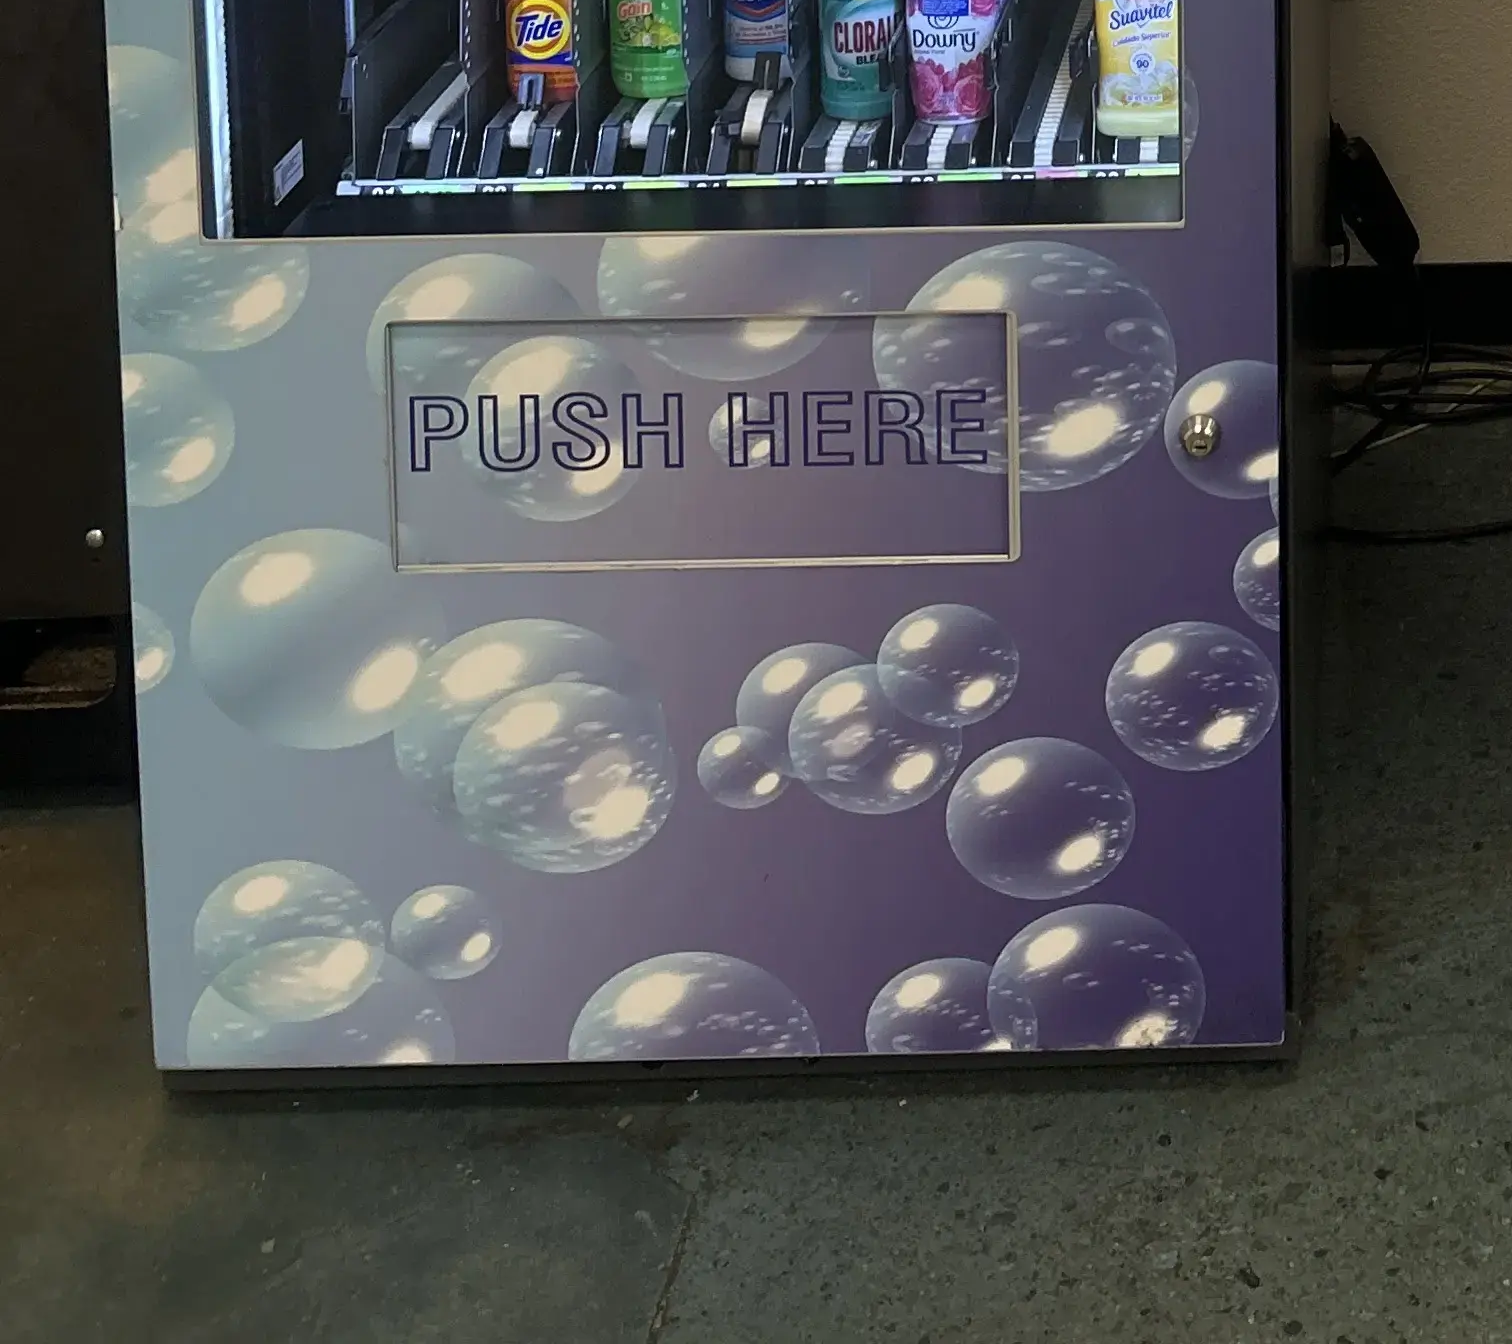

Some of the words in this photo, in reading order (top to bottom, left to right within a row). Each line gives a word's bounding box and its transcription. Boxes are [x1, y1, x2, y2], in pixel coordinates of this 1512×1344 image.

[515, 14, 563, 47] Tide
[1109, 2, 1173, 31] Suavitel
[912, 29, 980, 52] Downy
[410, 392, 685, 472] PUSH
[727, 389, 987, 468] HERE
